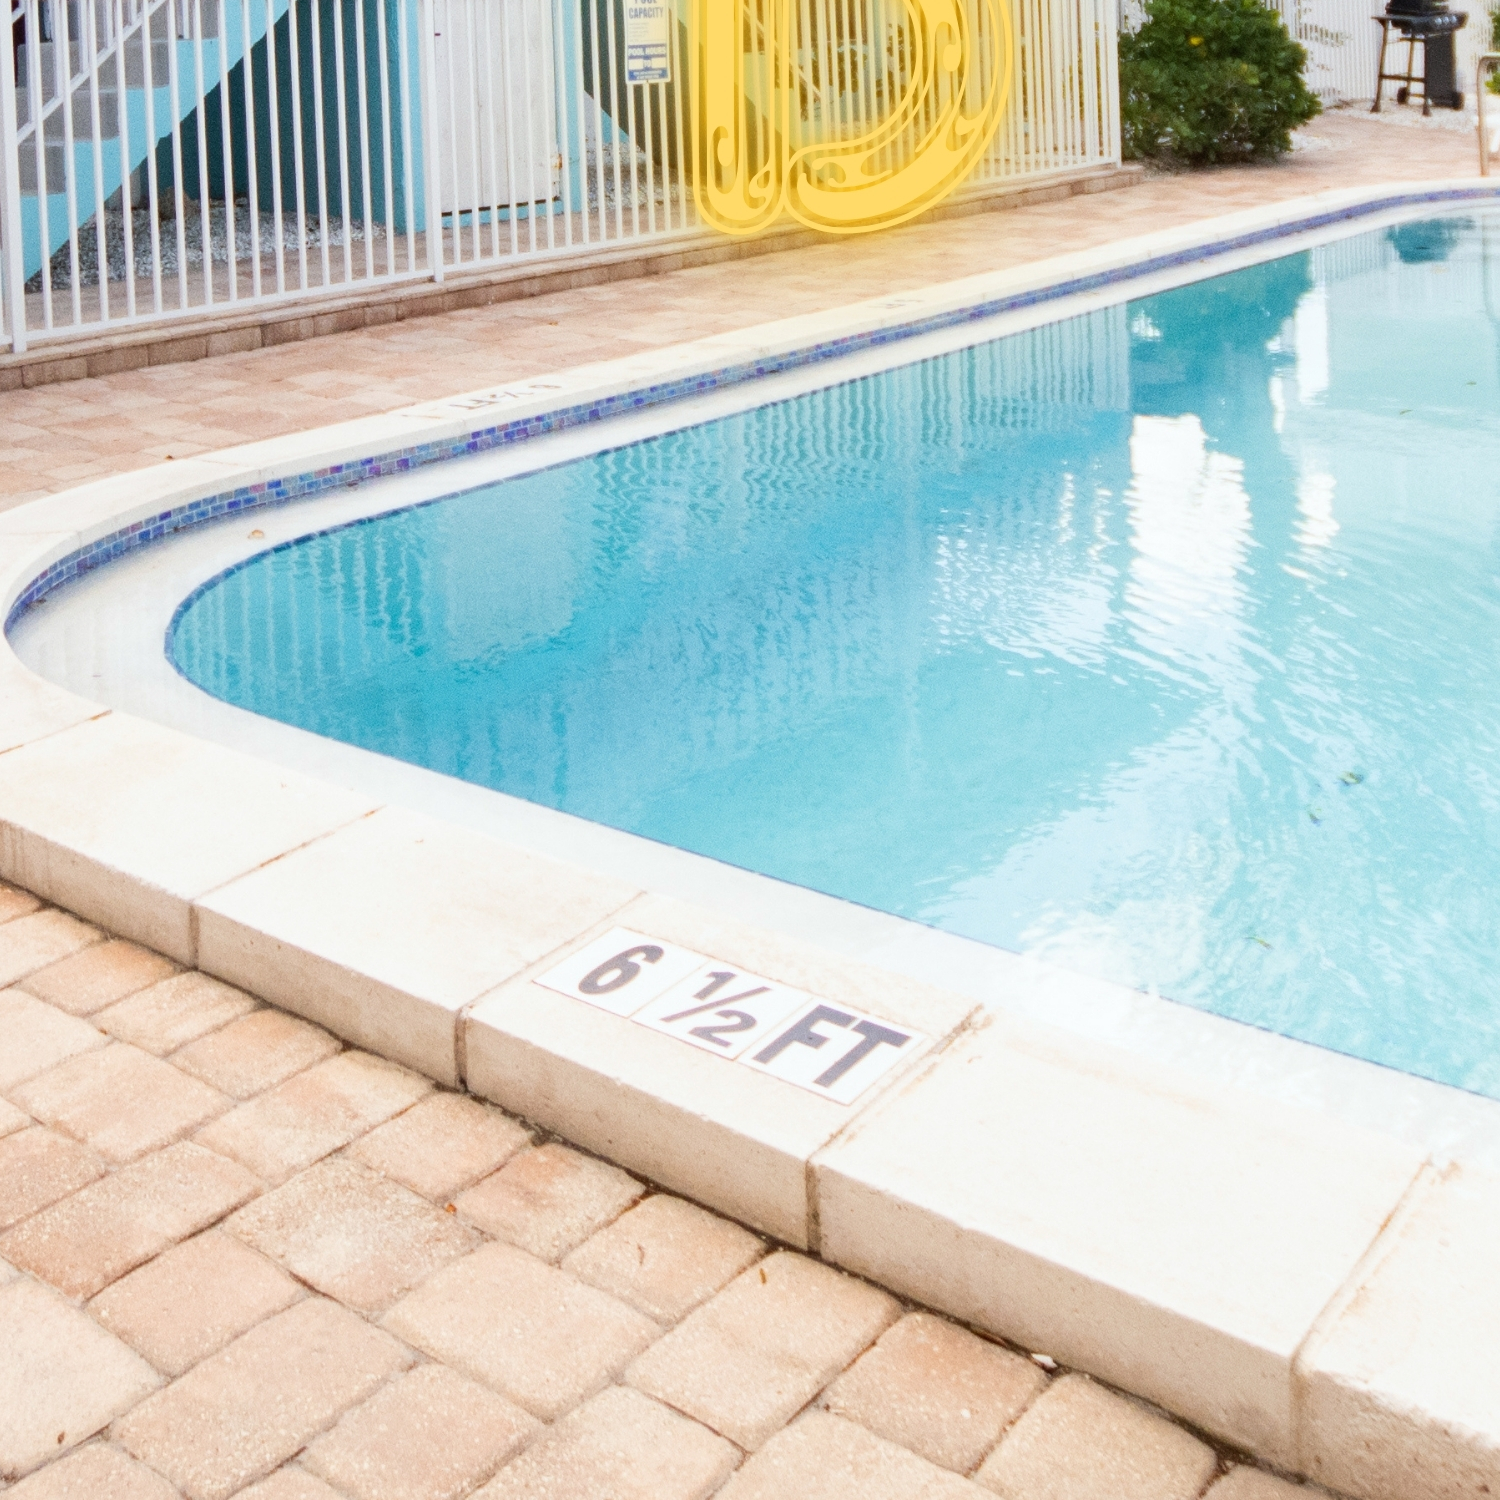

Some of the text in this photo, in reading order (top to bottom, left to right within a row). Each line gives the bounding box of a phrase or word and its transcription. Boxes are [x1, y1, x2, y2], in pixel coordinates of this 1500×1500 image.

[628, 7, 664, 19] CAPACITY
[577, 944, 665, 996] 6
[752, 1003, 913, 1089] FT
